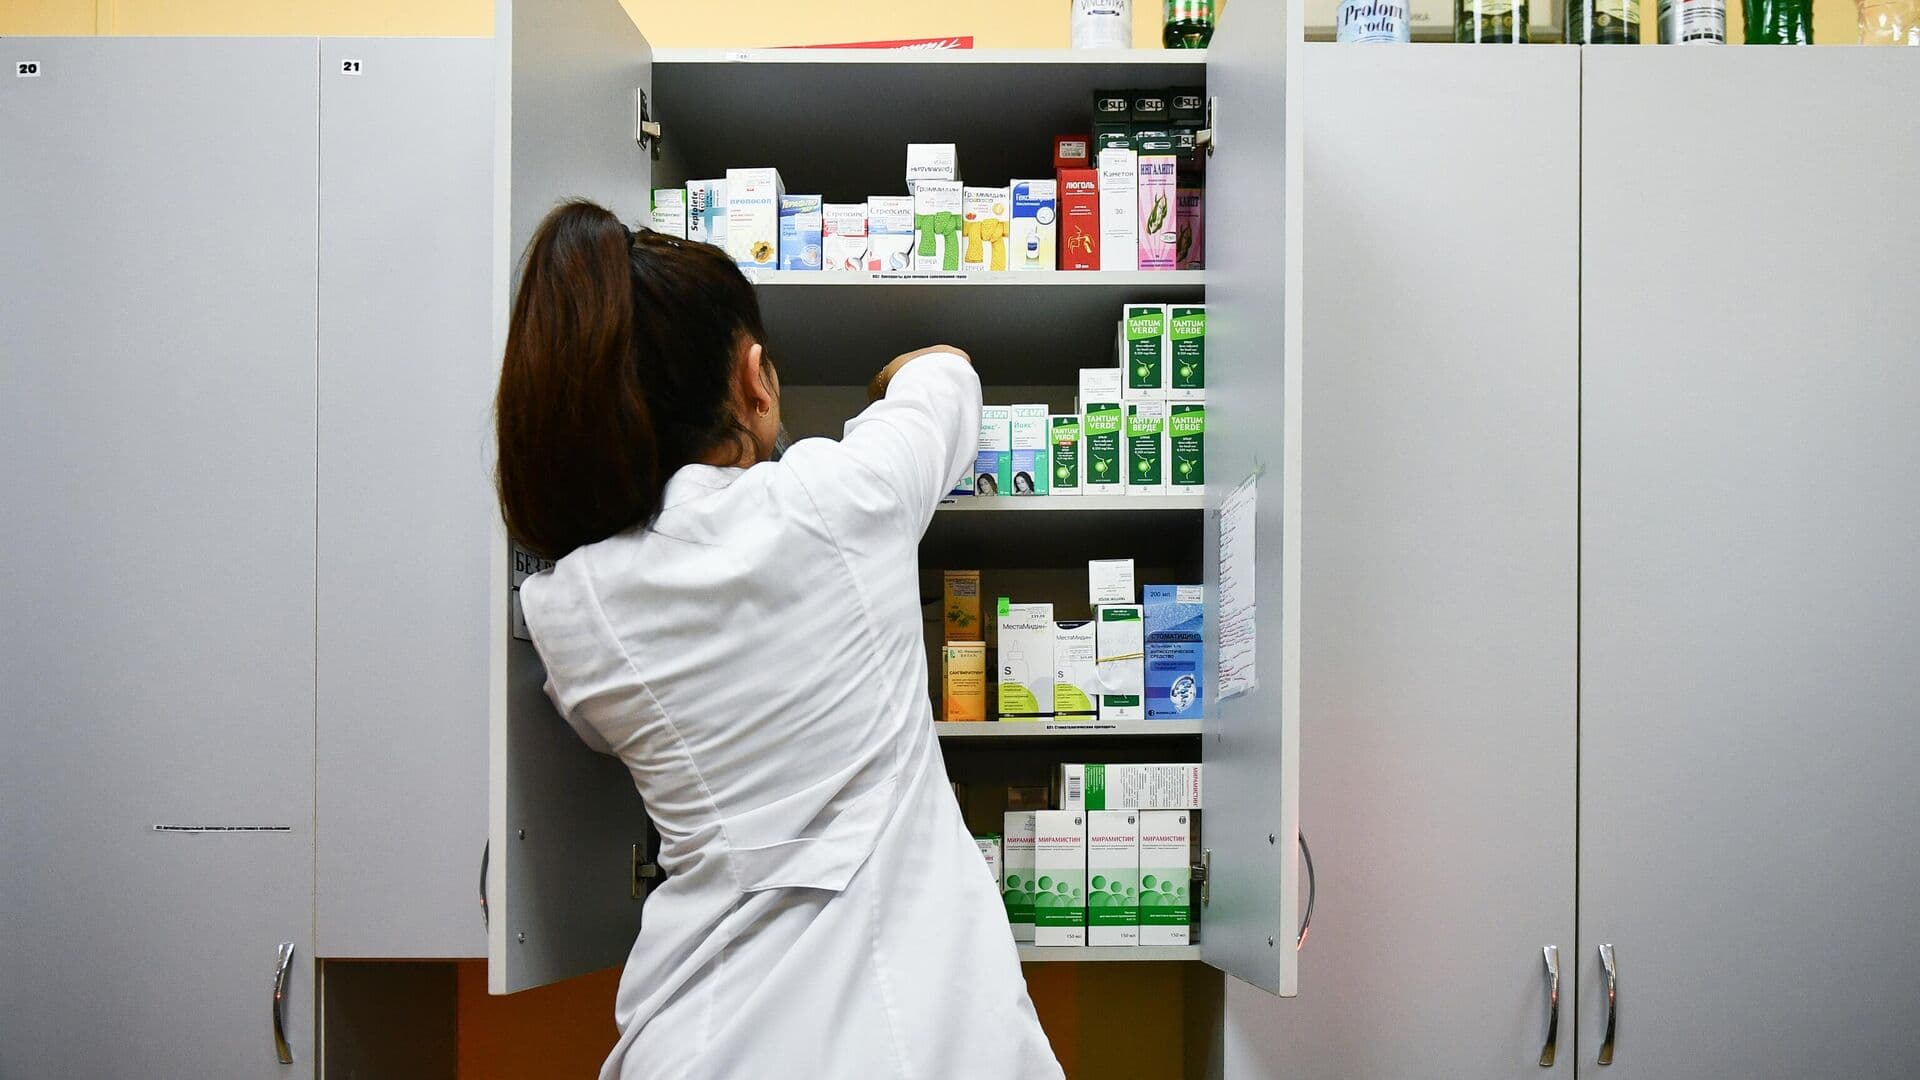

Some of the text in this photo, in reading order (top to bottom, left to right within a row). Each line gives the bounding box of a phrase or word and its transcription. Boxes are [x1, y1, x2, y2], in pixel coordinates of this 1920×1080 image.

[1345, 0, 1402, 26] Prolom
[19, 64, 37, 74] 20
[343, 62, 360, 71] 21
[691, 191, 700, 231] Septolete
[1129, 320, 1160, 328] TANTUM
[1173, 320, 1204, 328] TANTUM
[1087, 415, 1120, 423] TANTUM
[1004, 666, 1012, 675] S
[1057, 670, 1065, 678] S
